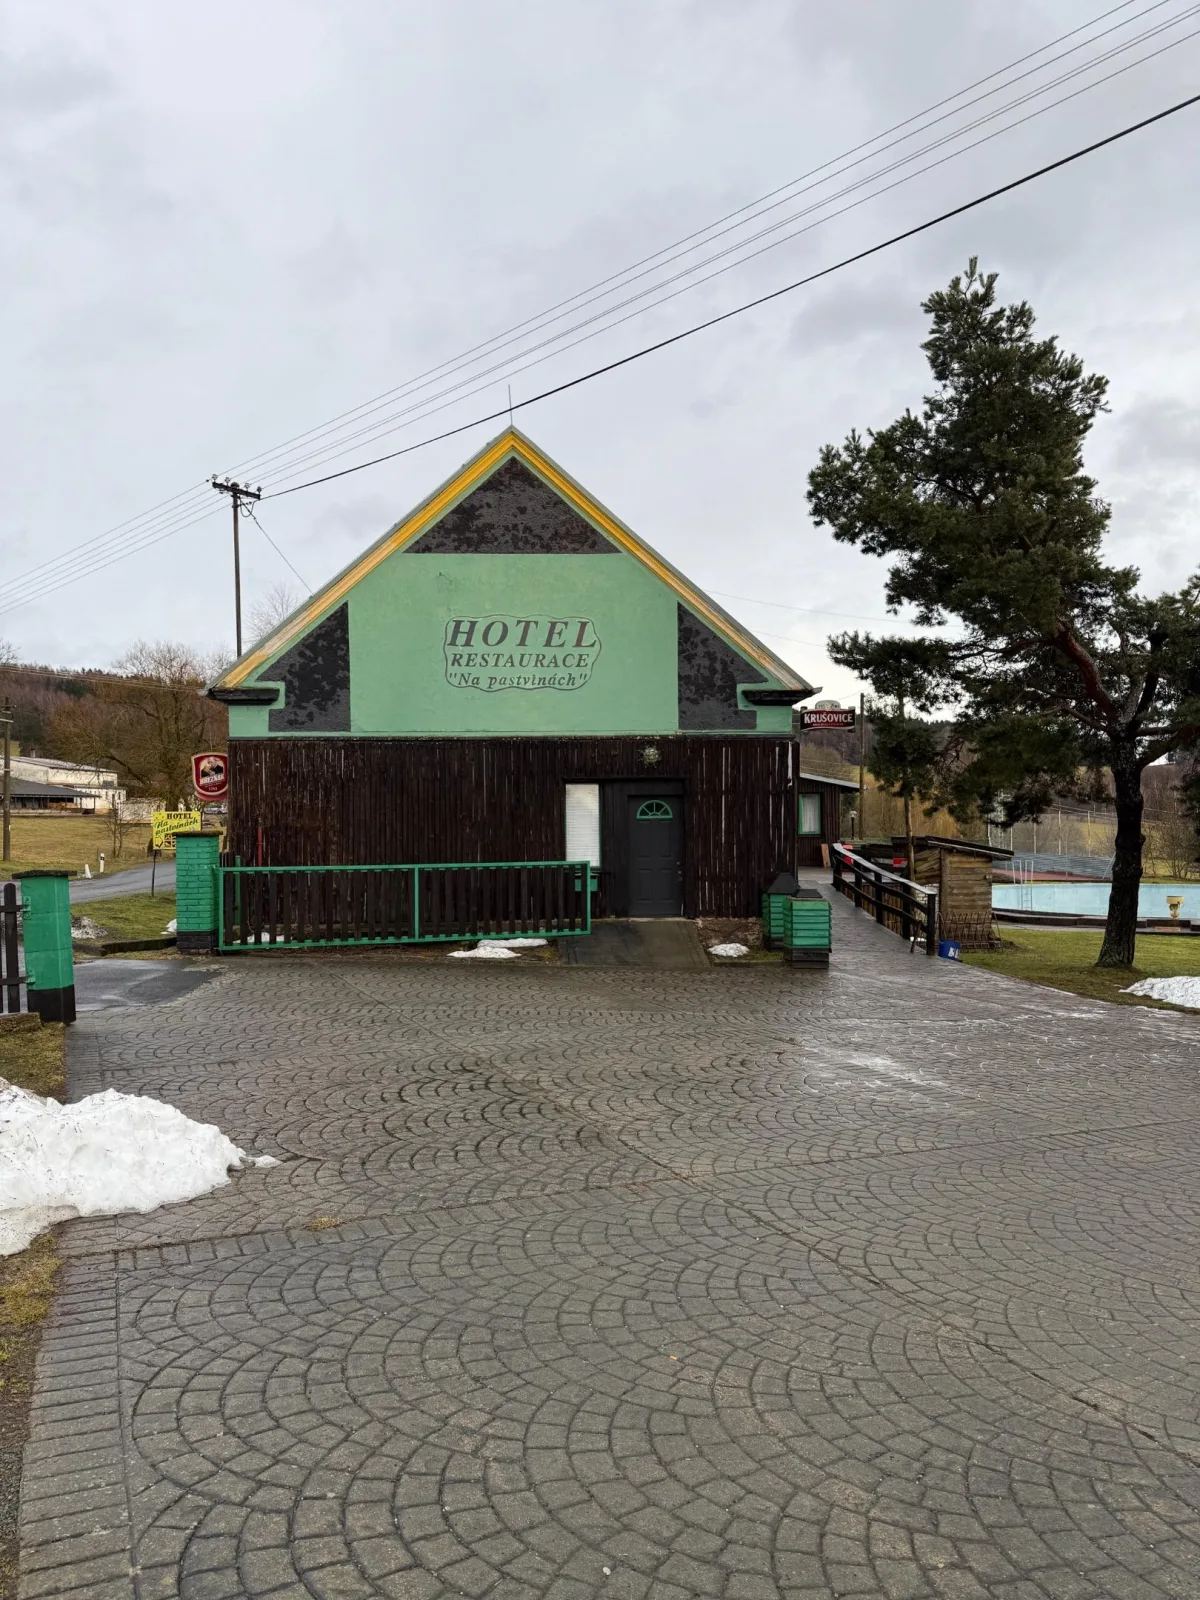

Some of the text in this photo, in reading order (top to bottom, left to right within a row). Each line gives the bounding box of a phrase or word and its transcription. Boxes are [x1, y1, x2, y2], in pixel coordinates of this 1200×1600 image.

[447, 620, 597, 648] HOTEL
[450, 653, 590, 668] RESTAURACE
[449, 672, 588, 689] "Na pastvinách"
[804, 712, 853, 723] KRUŠOVICE
[155, 820, 168, 829] Na
